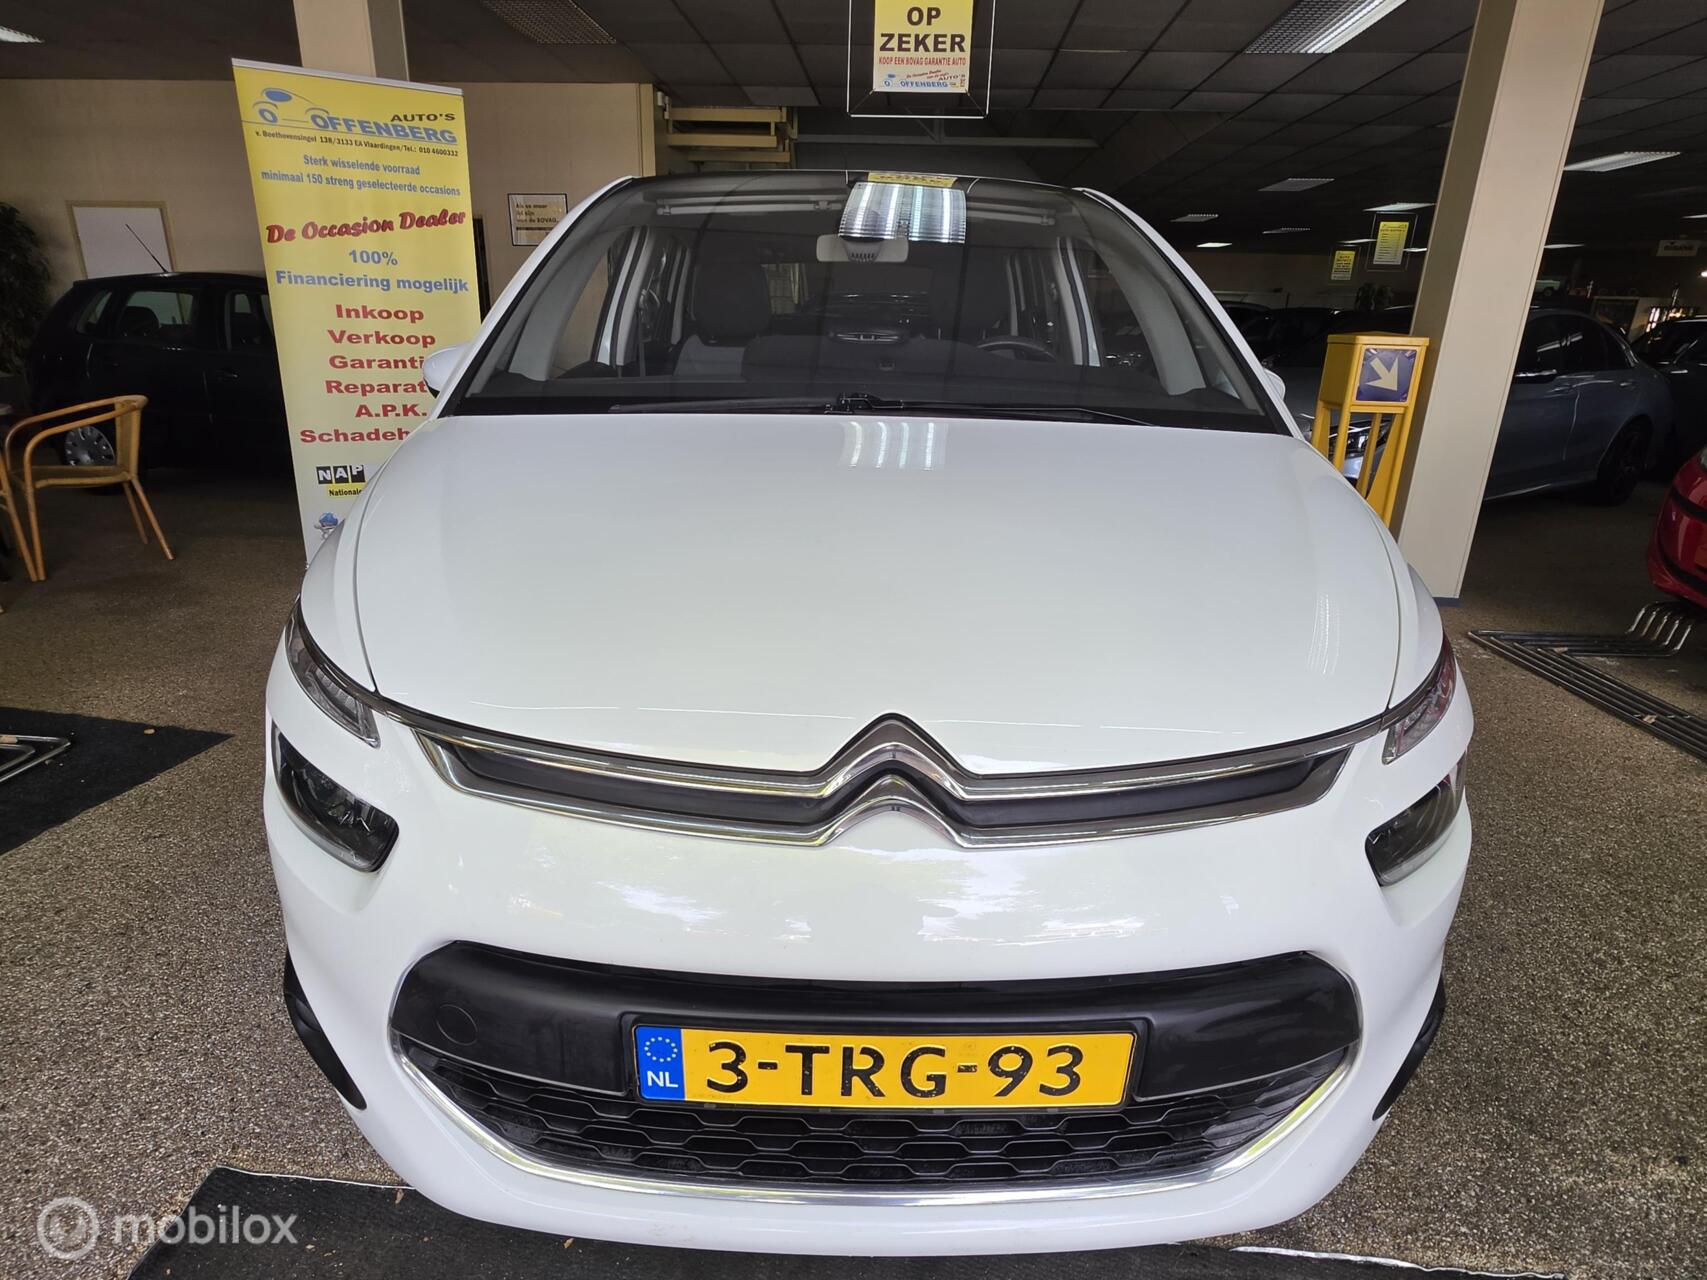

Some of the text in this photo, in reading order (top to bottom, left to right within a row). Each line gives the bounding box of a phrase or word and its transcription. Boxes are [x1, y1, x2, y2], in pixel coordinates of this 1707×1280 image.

[907, 6, 942, 26] OP
[879, 33, 966, 53] ZEKER
[879, 56, 967, 66] KOOP EEN BOVAG GARANTIE AUTO
[900, 80, 948, 88] OFFENBERG
[391, 112, 456, 123] AUTO'S
[310, 114, 458, 144] OFFENBERG
[303, 154, 421, 176] Sterk wisselende voorraad
[261, 170, 462, 197] minimaal 150 streng geselecteerde occasions
[266, 209, 467, 244] De Occasion Dealer
[349, 249, 399, 267] 100%
[275, 270, 469, 294] Financiering mogelijk
[335, 304, 425, 324] Inkoop
[327, 329, 436, 348] Verkoop
[329, 355, 425, 370] Garanti
[325, 380, 428, 397] Reparat
[355, 404, 428, 418] A.P.K.
[300, 428, 411, 444] Schadeh
[317, 464, 364, 481] NAP
[646, 1040, 1084, 1098] NL 3-TRG-93
